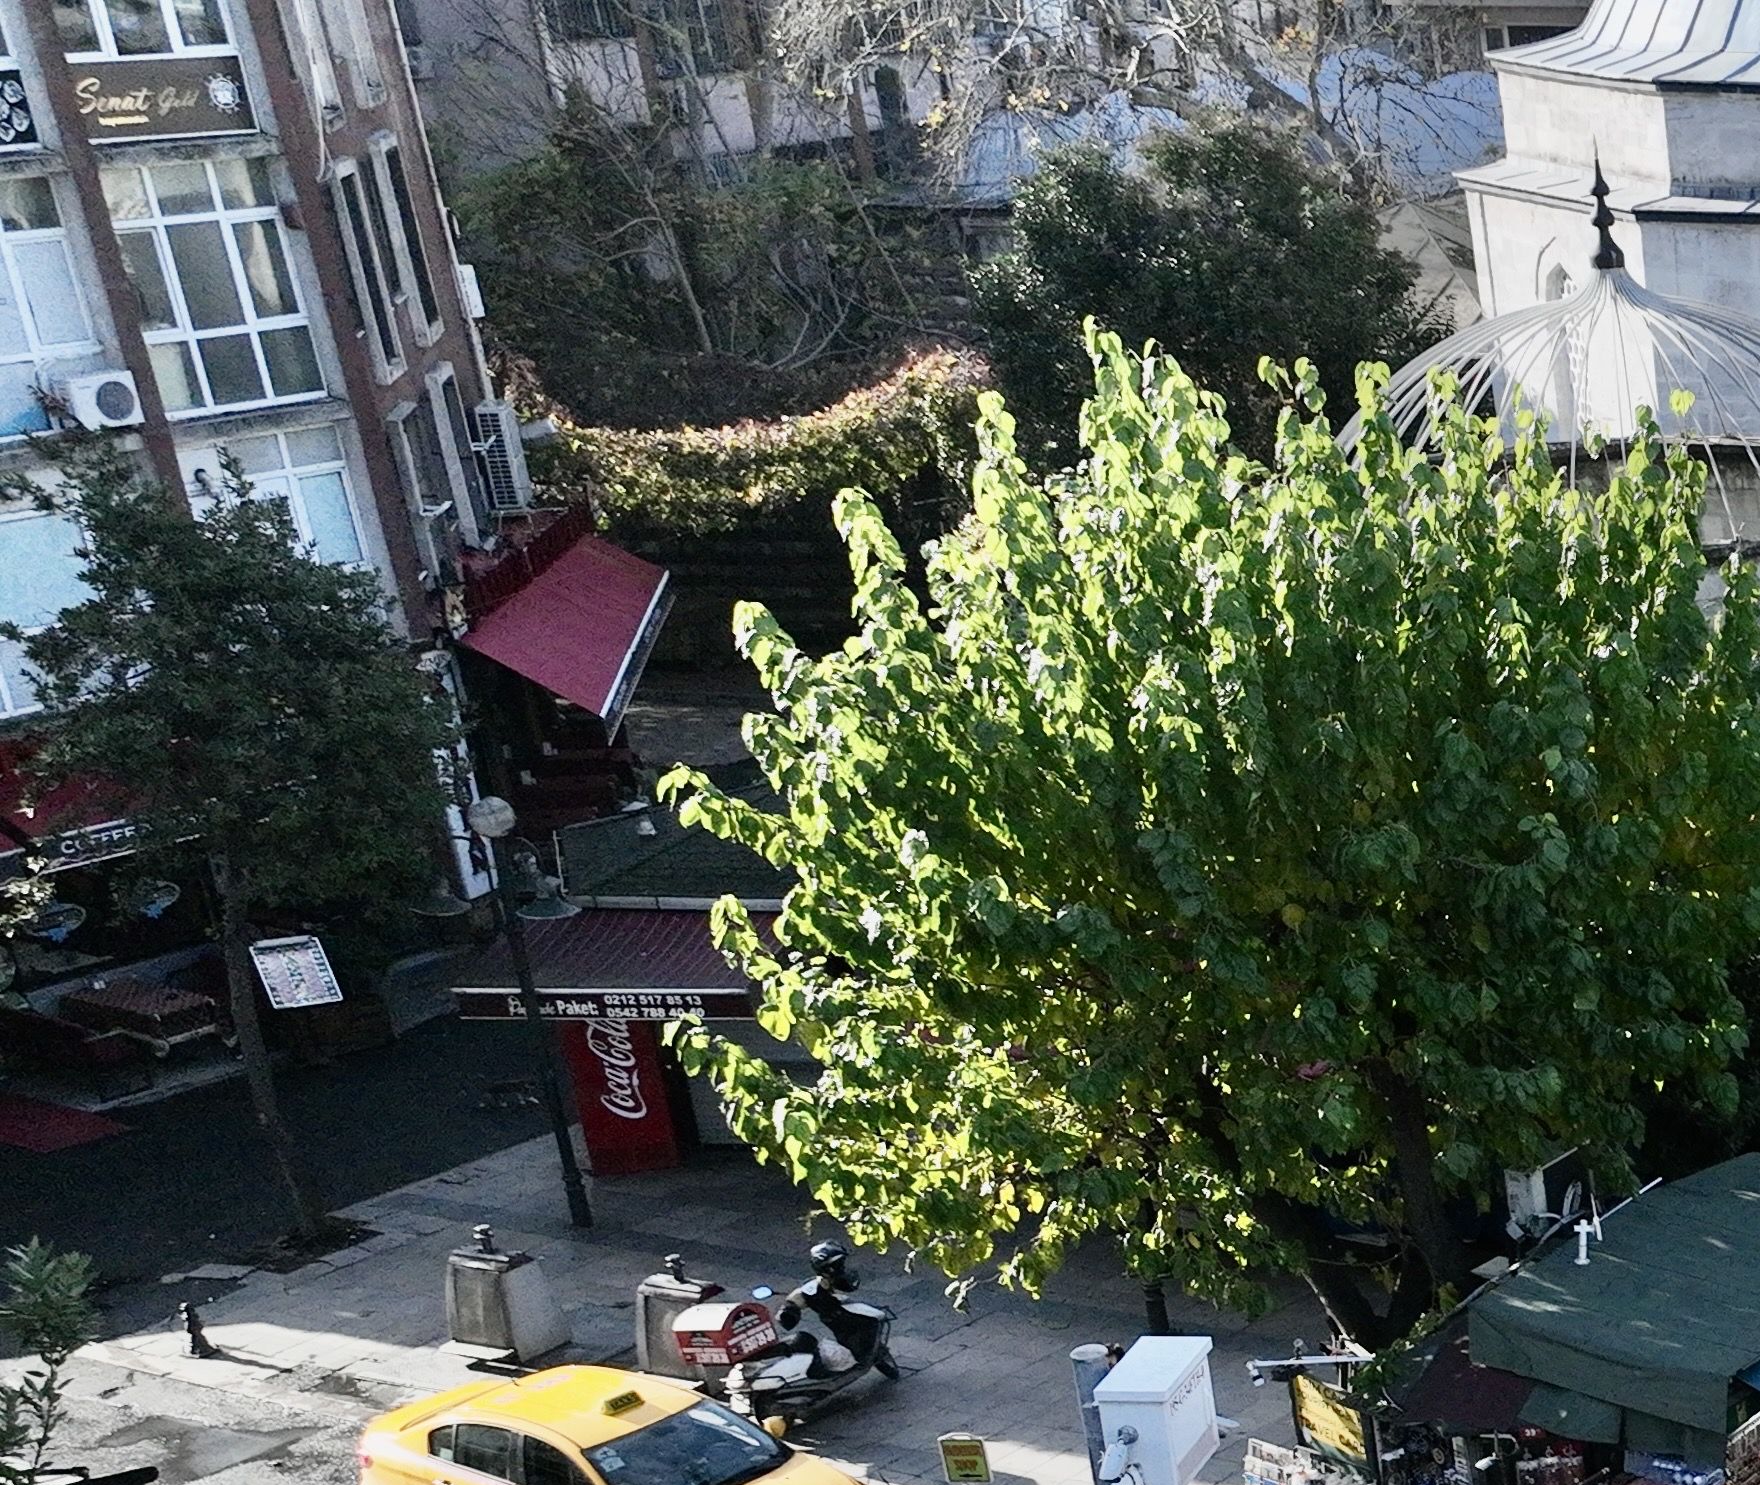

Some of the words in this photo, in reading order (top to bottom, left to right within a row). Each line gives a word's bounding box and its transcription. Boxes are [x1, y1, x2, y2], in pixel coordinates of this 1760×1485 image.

[76, 77, 152, 114] Senat
[556, 1000, 600, 1016] Paket:
[604, 994, 637, 1006] 0212
[639, 994, 663, 1006] 517
[665, 995, 684, 1006] 85
[685, 995, 703, 1007] 13
[606, 1007, 638, 1018] 0542
[641, 1007, 666, 1018] 788
